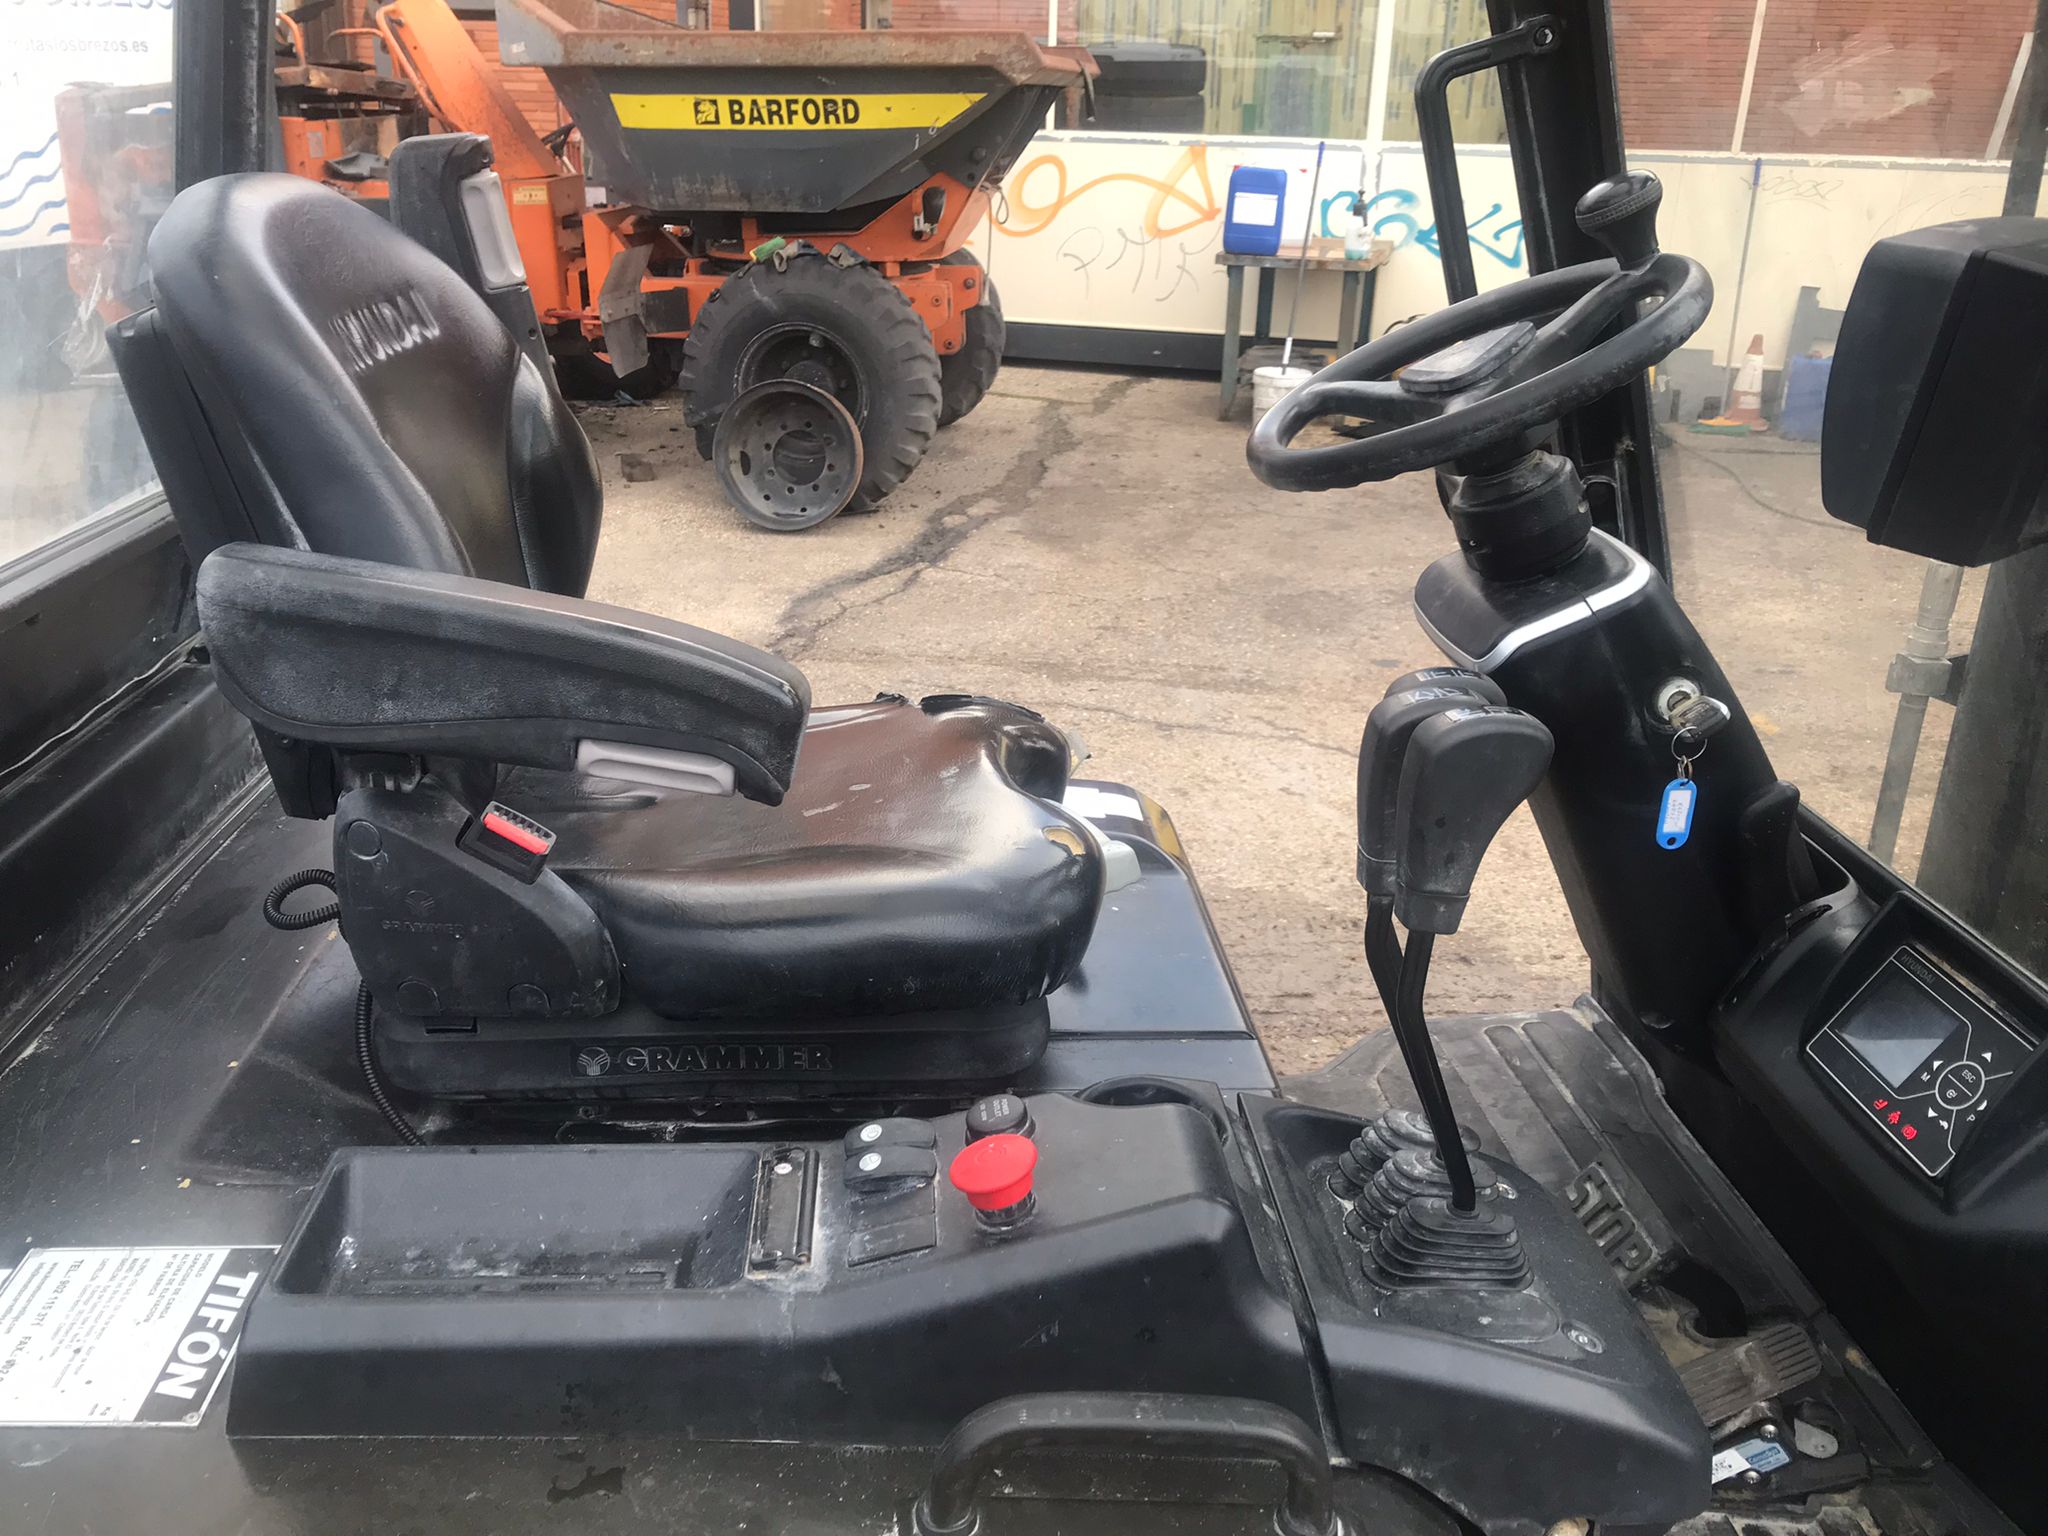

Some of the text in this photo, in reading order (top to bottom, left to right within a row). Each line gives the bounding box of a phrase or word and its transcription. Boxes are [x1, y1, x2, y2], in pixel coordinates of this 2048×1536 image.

[728, 98, 860, 126] BARFORD
[1900, 954, 1936, 985] HYUNDAI
[618, 1044, 834, 1073] GRAMMER
[1961, 1068, 1976, 1084] ESC
[1565, 1164, 1655, 1275] STOP
[154, 1272, 259, 1400] TIFÓN
